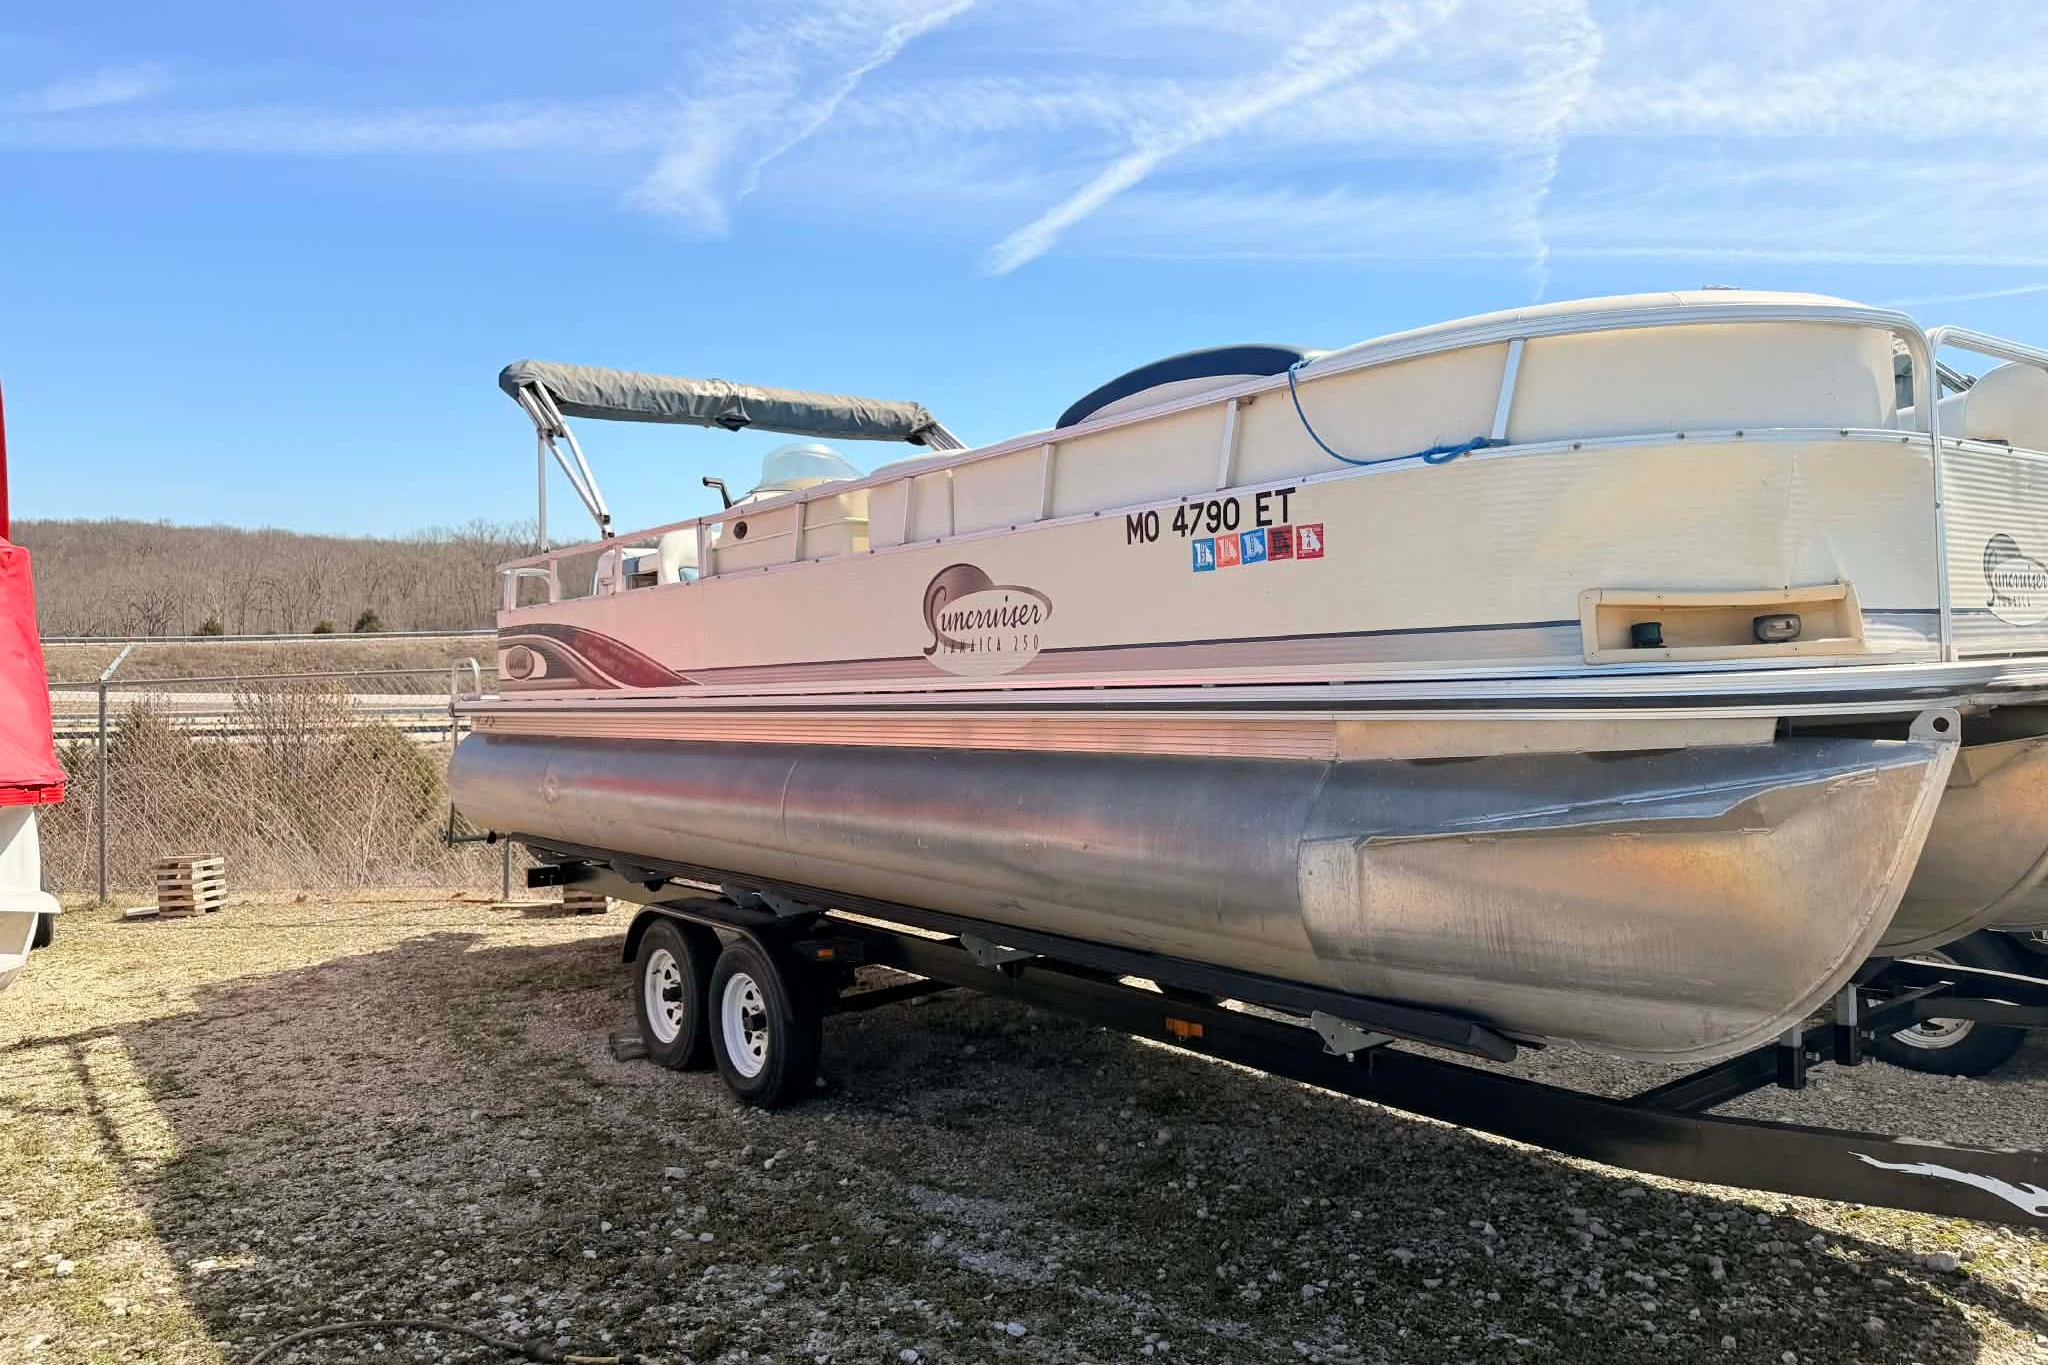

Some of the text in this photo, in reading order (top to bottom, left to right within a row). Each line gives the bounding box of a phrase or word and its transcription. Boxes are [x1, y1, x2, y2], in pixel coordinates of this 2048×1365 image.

[1126, 487, 1296, 545] MO 4790 ET
[923, 586, 1041, 655] Suncruiser
[1014, 634, 1039, 651] 250
